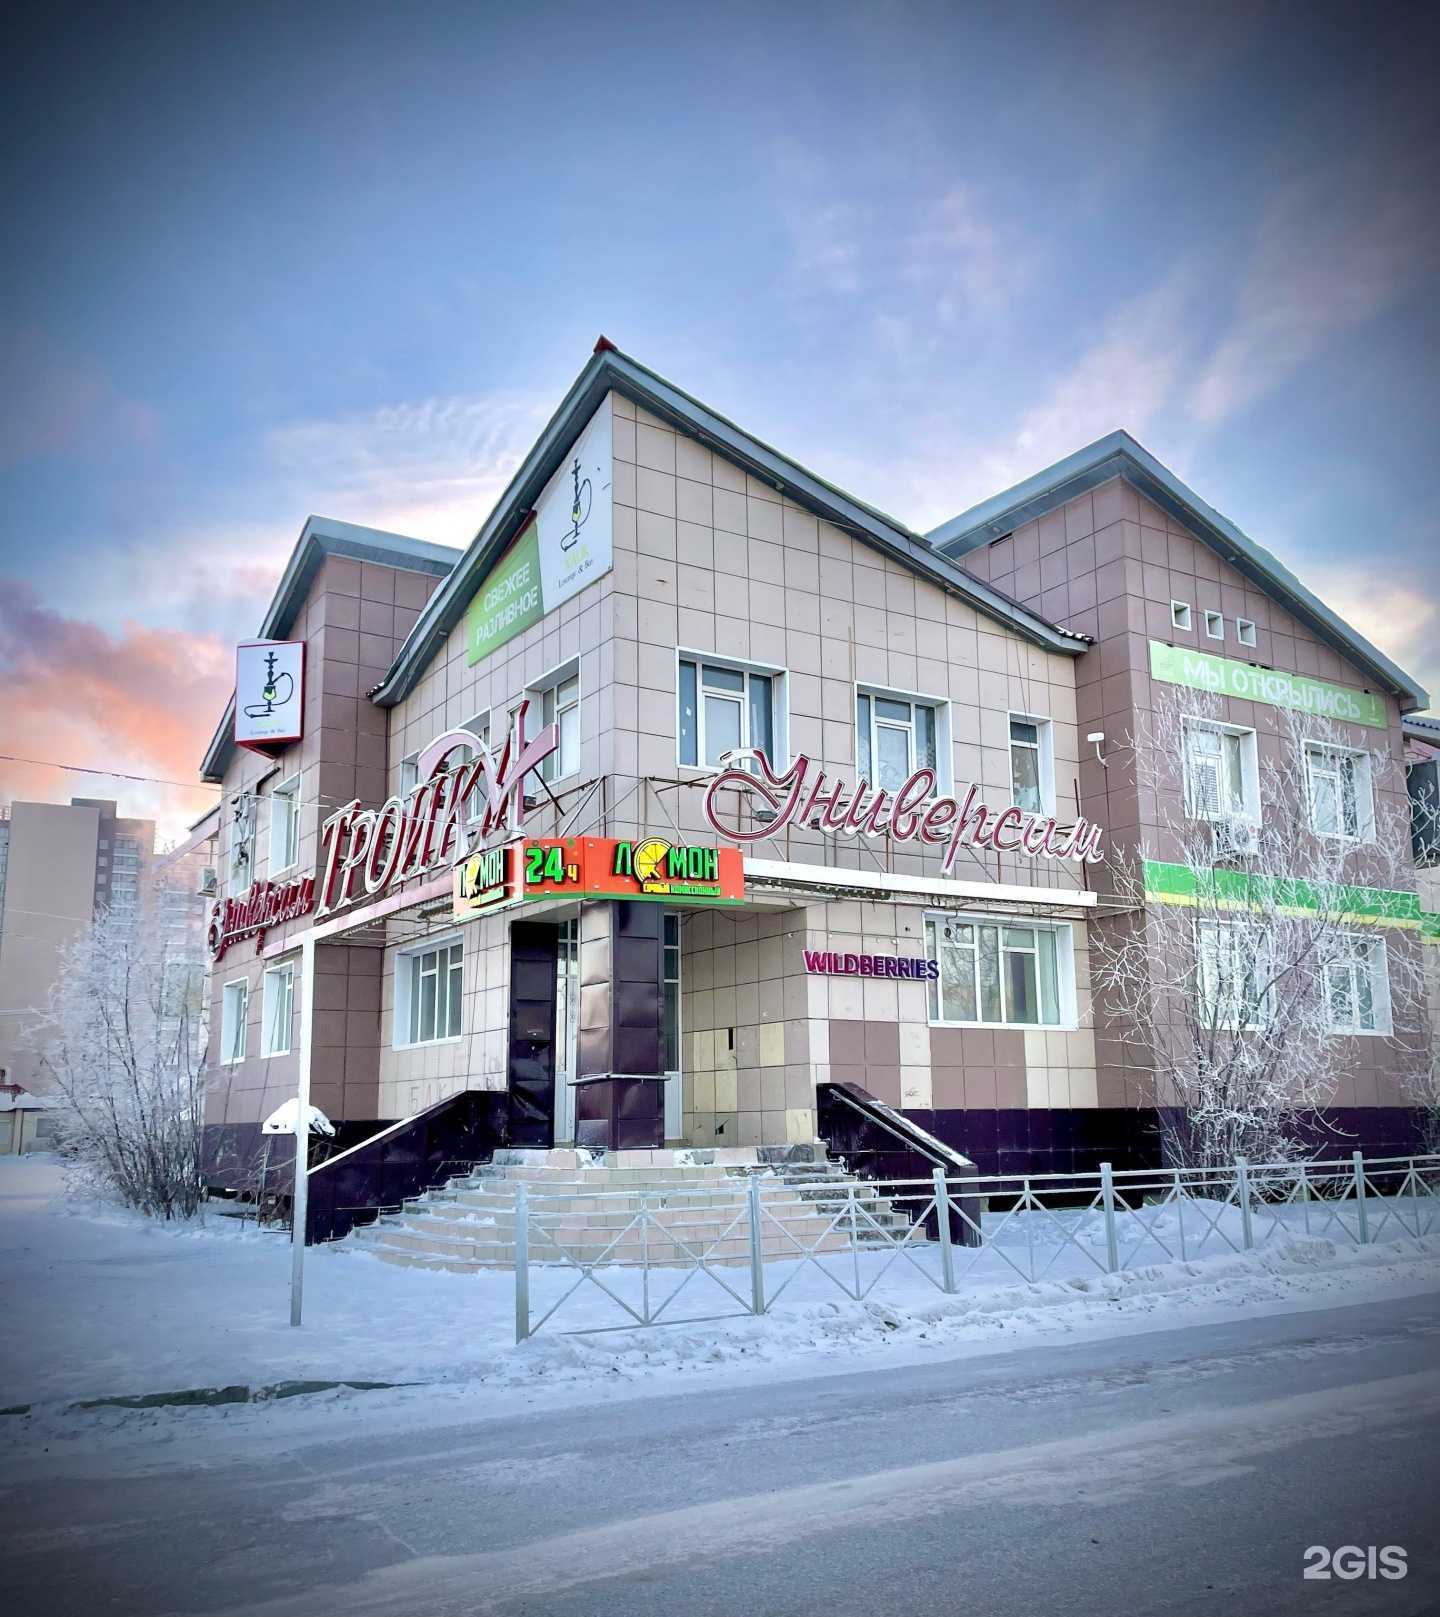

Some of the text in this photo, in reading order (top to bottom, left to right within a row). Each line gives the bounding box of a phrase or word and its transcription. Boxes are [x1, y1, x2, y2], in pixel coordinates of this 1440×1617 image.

[476, 585, 539, 647] РАЗЛИВНОЕ
[483, 562, 531, 613] СВЕЖЕЕ
[1183, 656, 1361, 719] МЫ ОТКРЫЛИСЬ
[703, 747, 1105, 875] Универсам
[802, 948, 940, 982] WILDBERRIES
